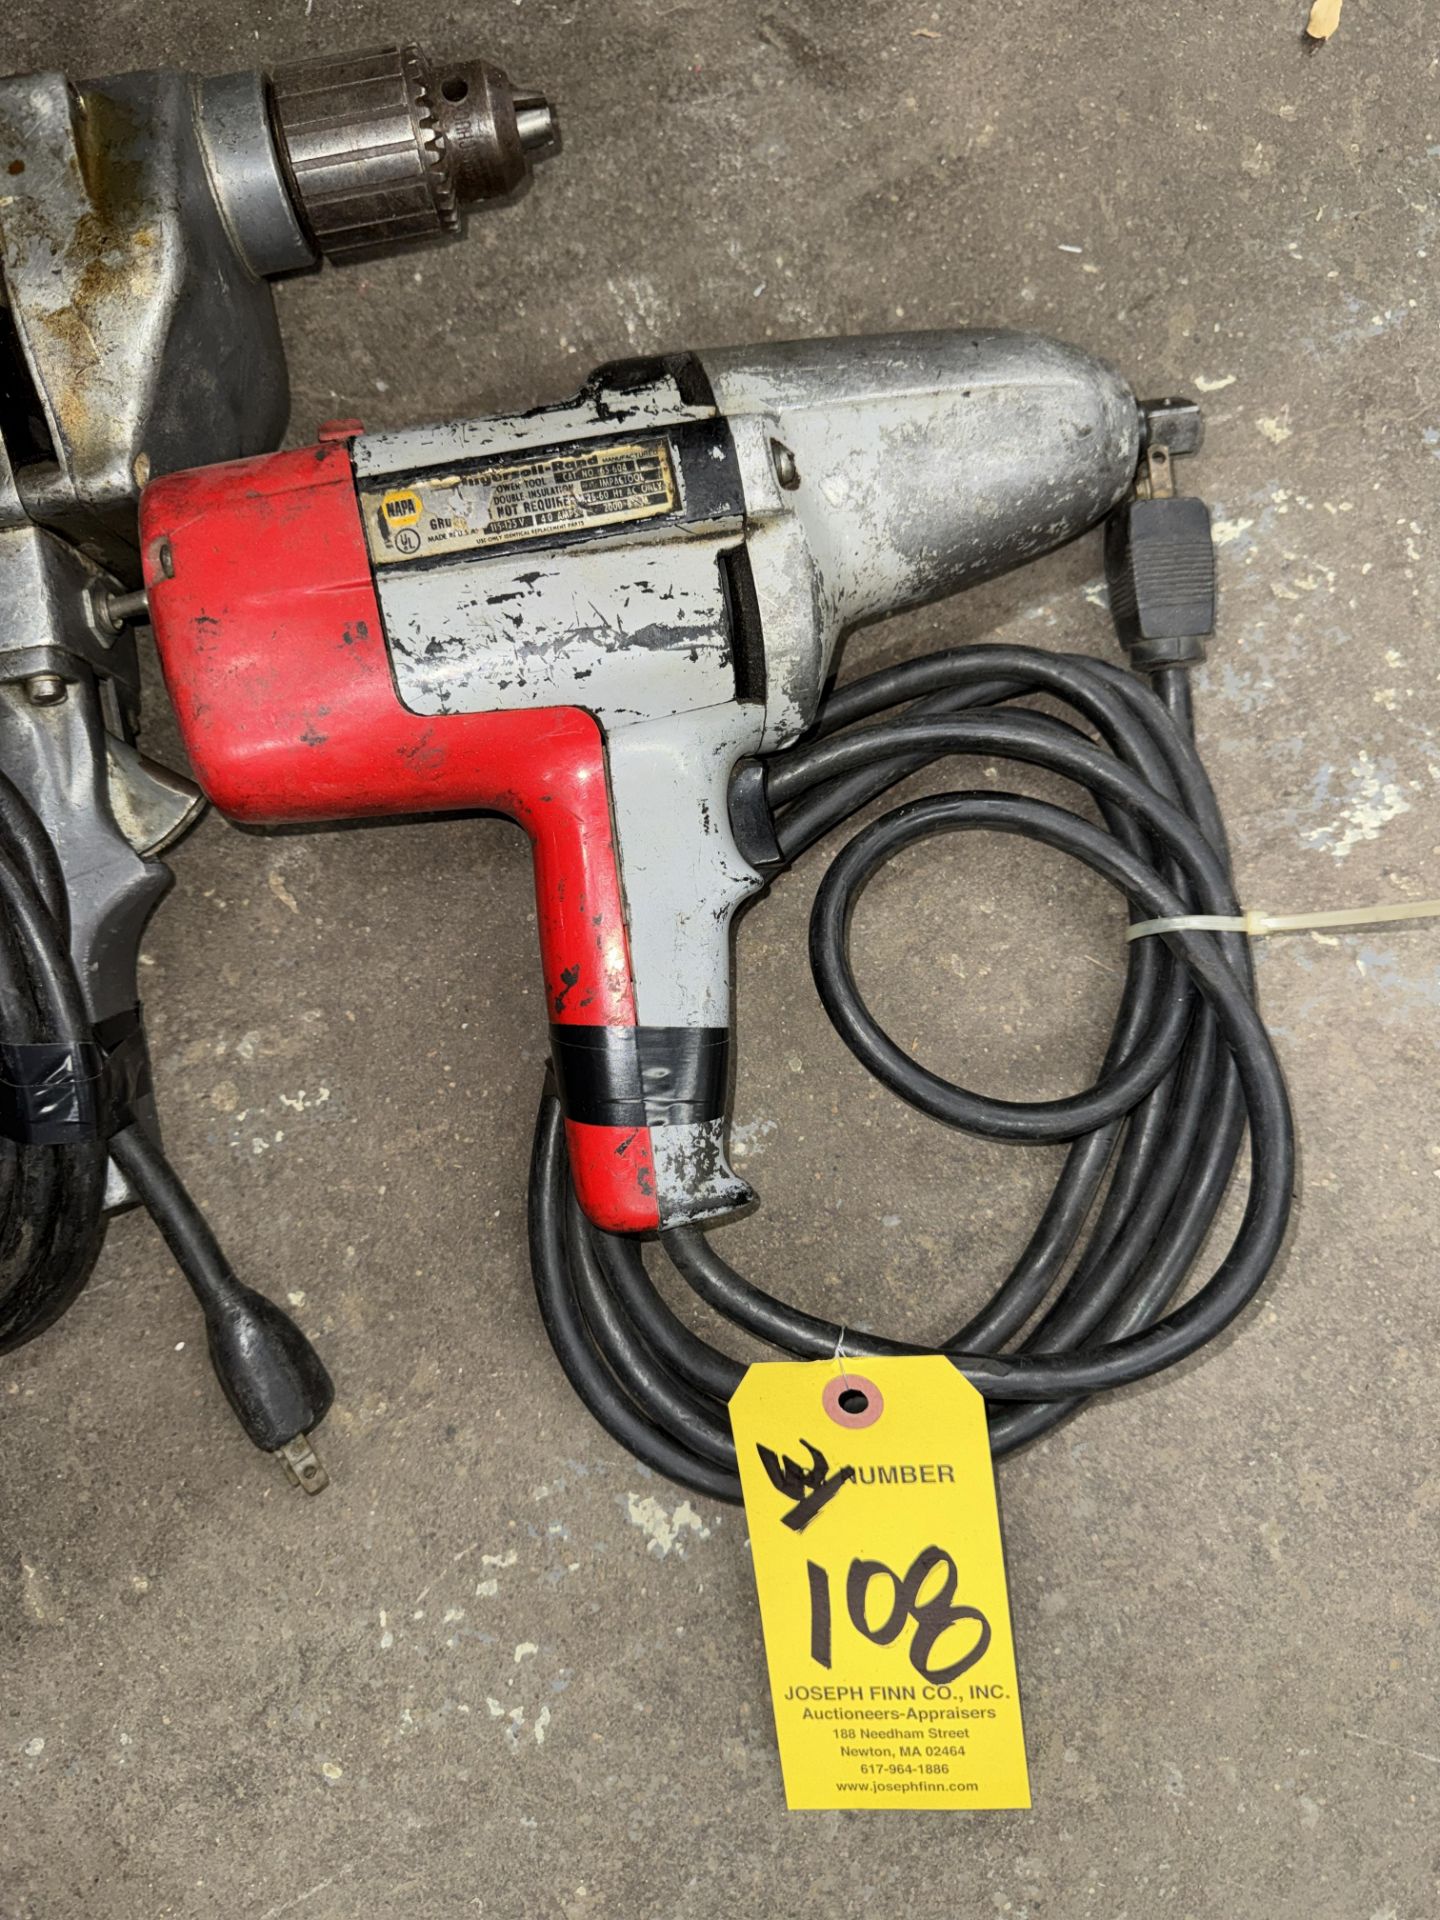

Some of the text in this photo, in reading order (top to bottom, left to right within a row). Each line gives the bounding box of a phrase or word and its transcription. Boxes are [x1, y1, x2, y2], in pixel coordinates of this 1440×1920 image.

[525, 477, 546, 488] TOOL
[494, 494, 525, 506] DOUBLE
[497, 495, 575, 518] NOT REQUIRE
[386, 499, 416, 517] NAPA
[807, 1545, 991, 1685] 108
[784, 1684, 1011, 1703] JOSEPH FINN CO., INC.
[802, 1706, 997, 1723] Auctioneers-Appraisers
[833, 1727, 970, 1740] 188 Needham Street
[840, 1745, 966, 1759] Newton, MA 02464
[860, 1764, 950, 1775] 617-964-1886
[836, 1780, 979, 1793] www.josephfinn.com
